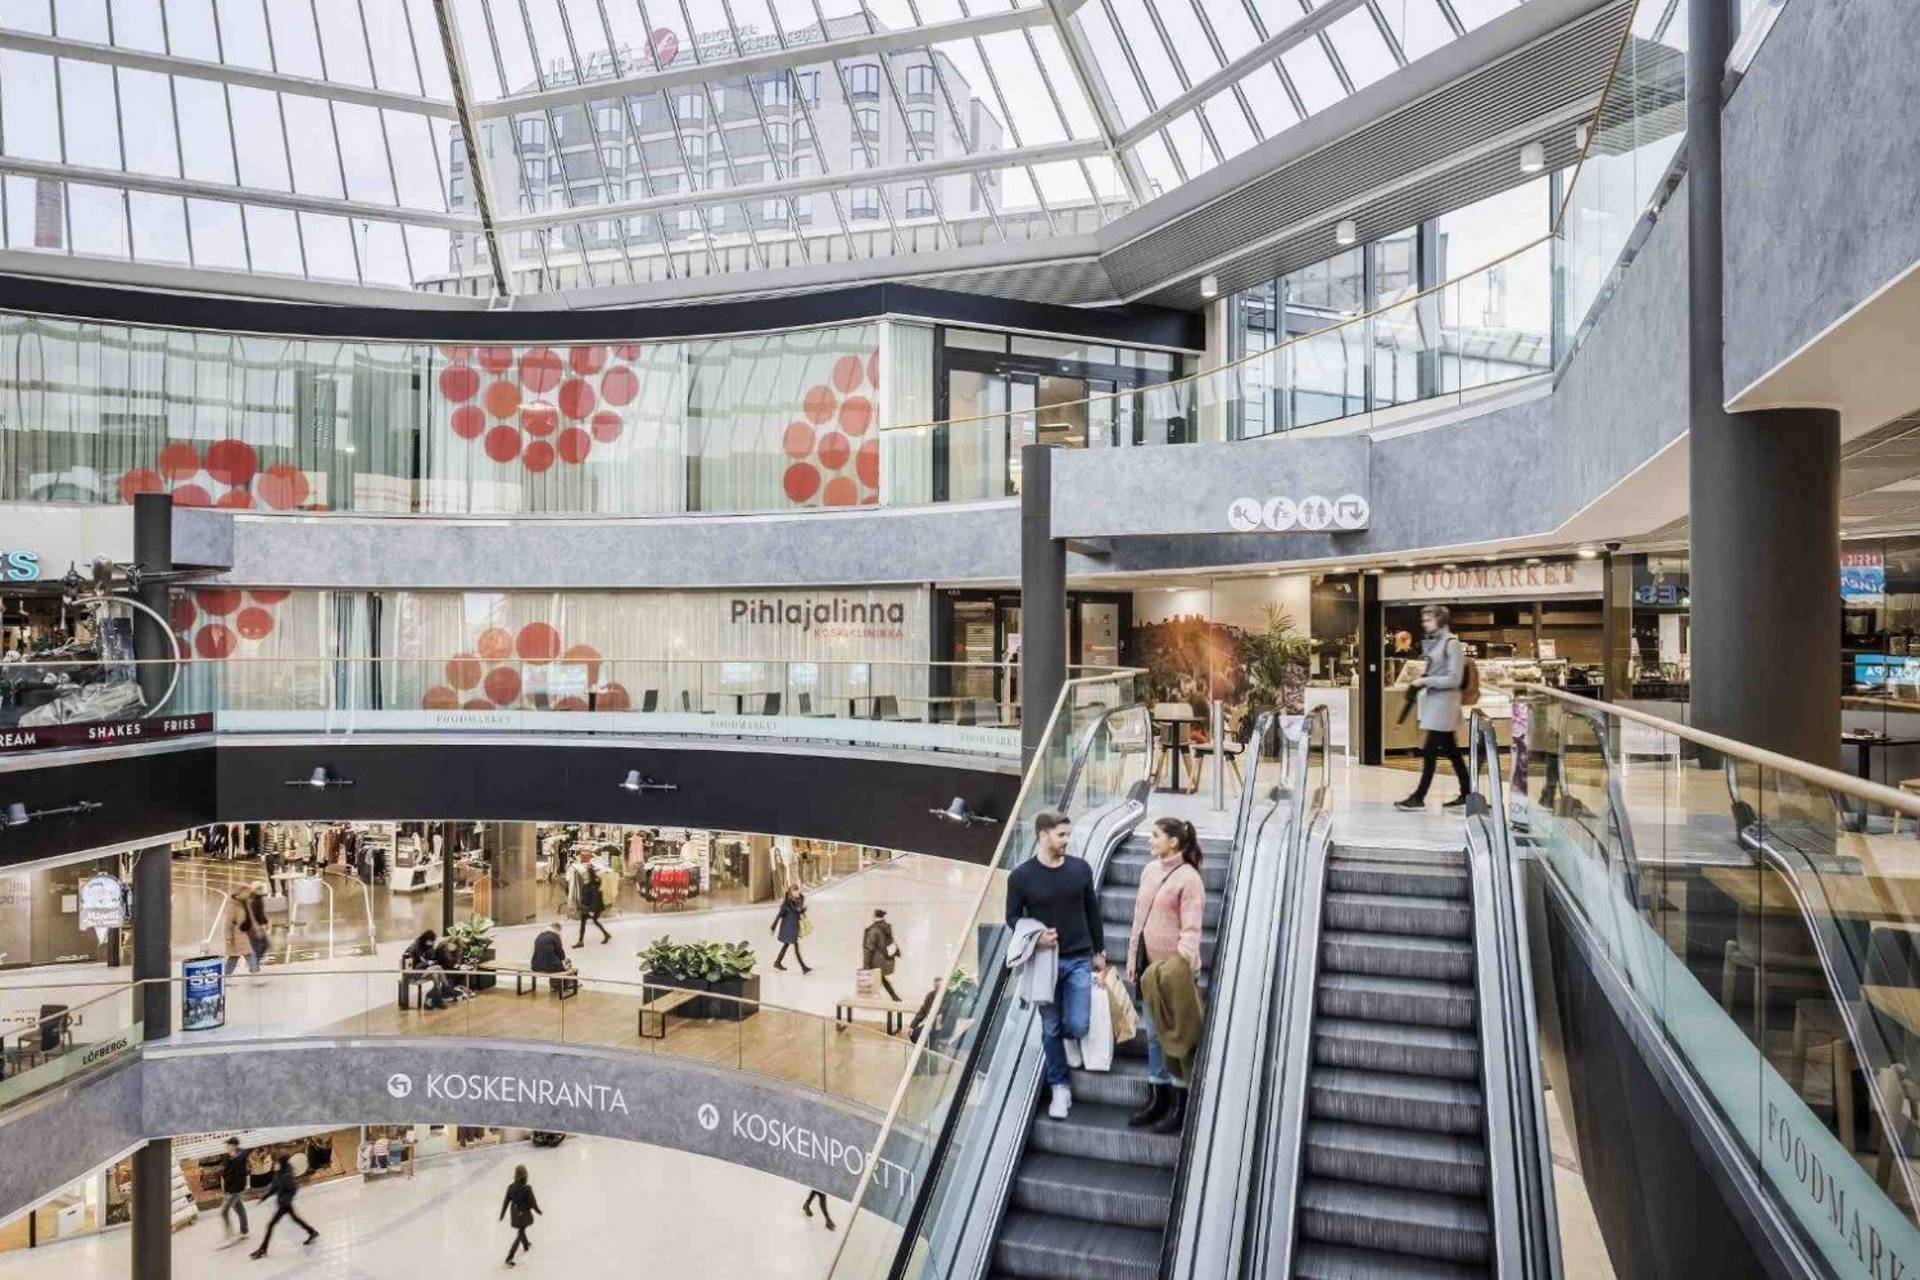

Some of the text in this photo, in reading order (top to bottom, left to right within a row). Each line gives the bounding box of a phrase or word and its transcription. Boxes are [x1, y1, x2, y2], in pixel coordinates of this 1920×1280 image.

[1410, 563, 1576, 591] FOODMARKET
[731, 598, 904, 632] Pihlajalinna
[88, 723, 141, 739] SHAKES
[163, 718, 196, 732] FRIES
[82, 1037, 128, 1066] LÖFBERGS
[426, 1073, 629, 1115] KOSKENRANTA
[1768, 1101, 1917, 1280] FOODMARK
